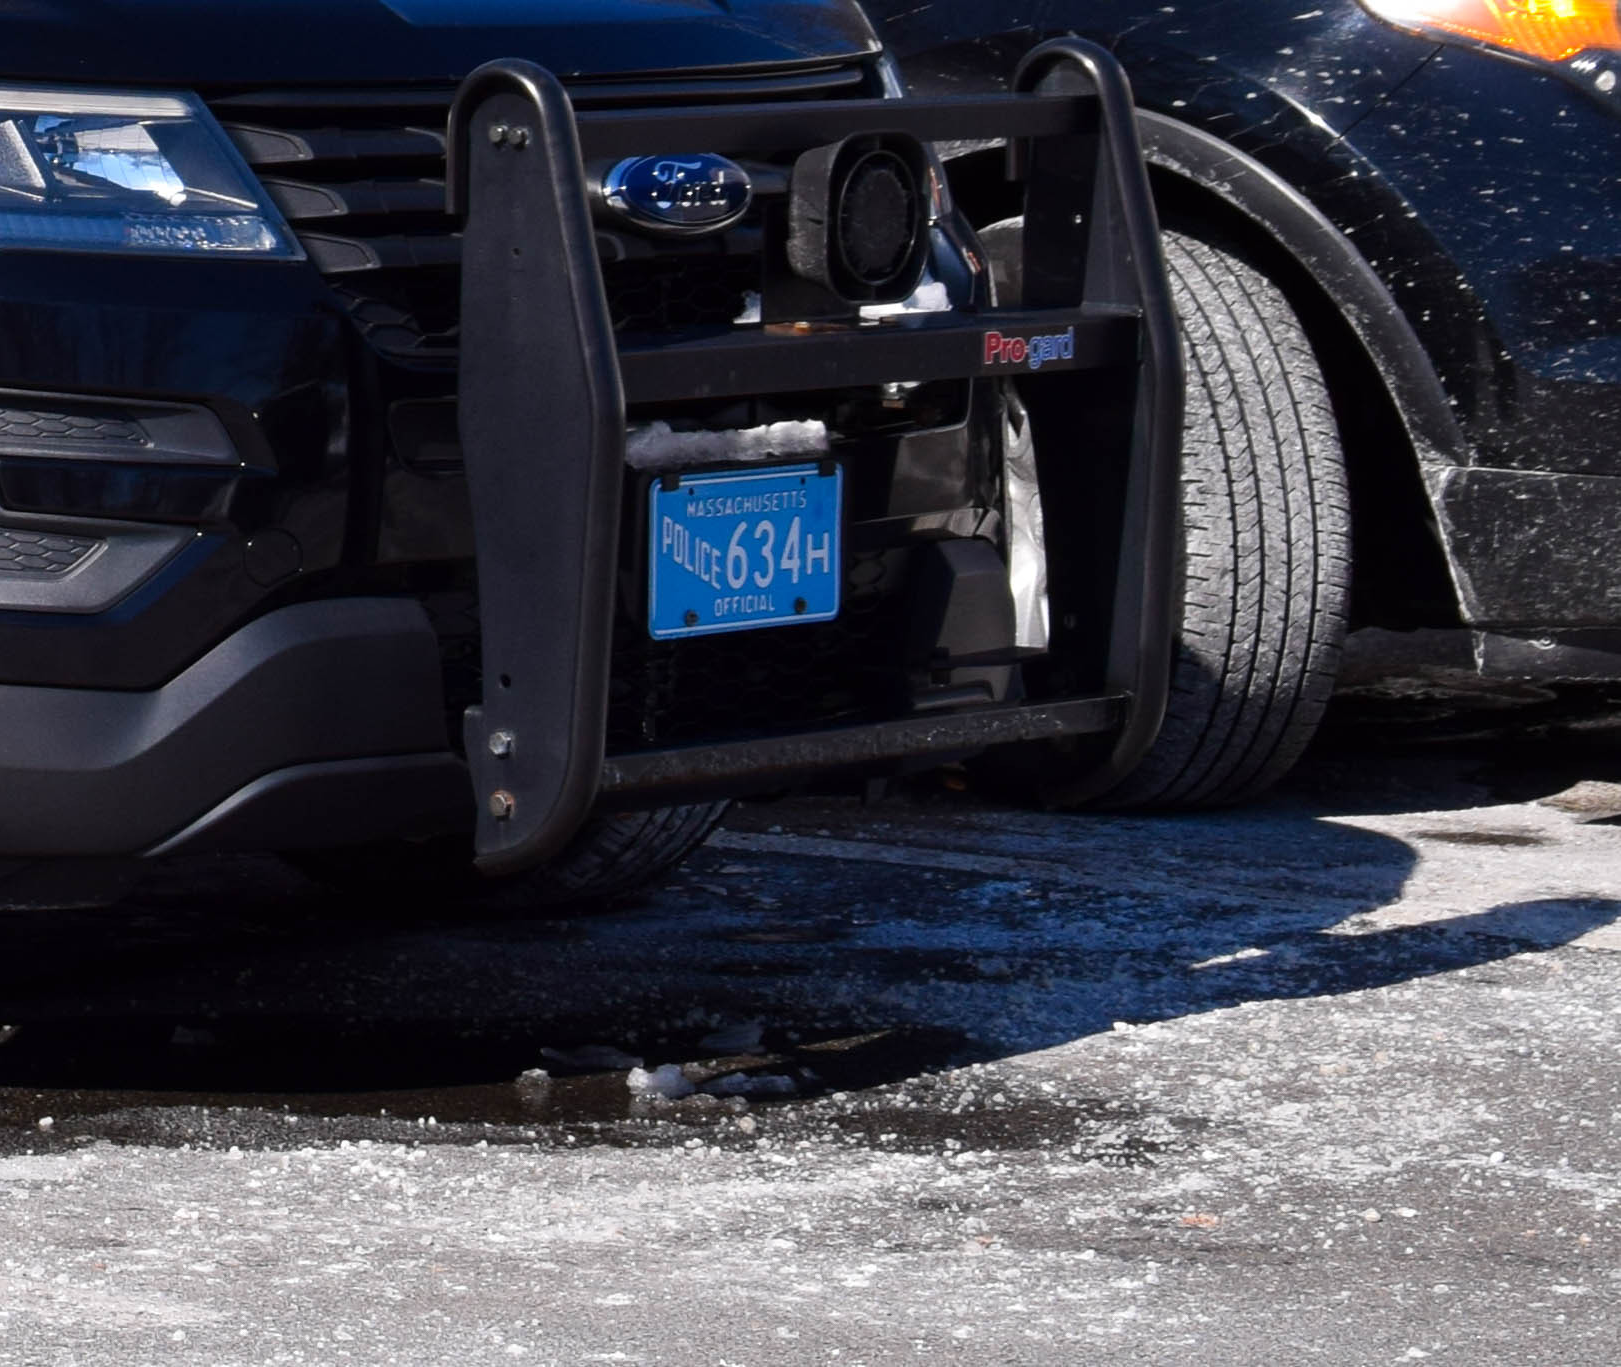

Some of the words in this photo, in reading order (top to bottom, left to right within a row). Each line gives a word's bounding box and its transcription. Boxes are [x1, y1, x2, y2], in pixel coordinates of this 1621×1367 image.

[984, 326, 1074, 369] Pro-gard
[687, 490, 807, 517] MASSACHUSETTS
[662, 516, 721, 589] POLICE
[726, 516, 830, 589] 634H
[714, 594, 776, 616] OFFICIAL
